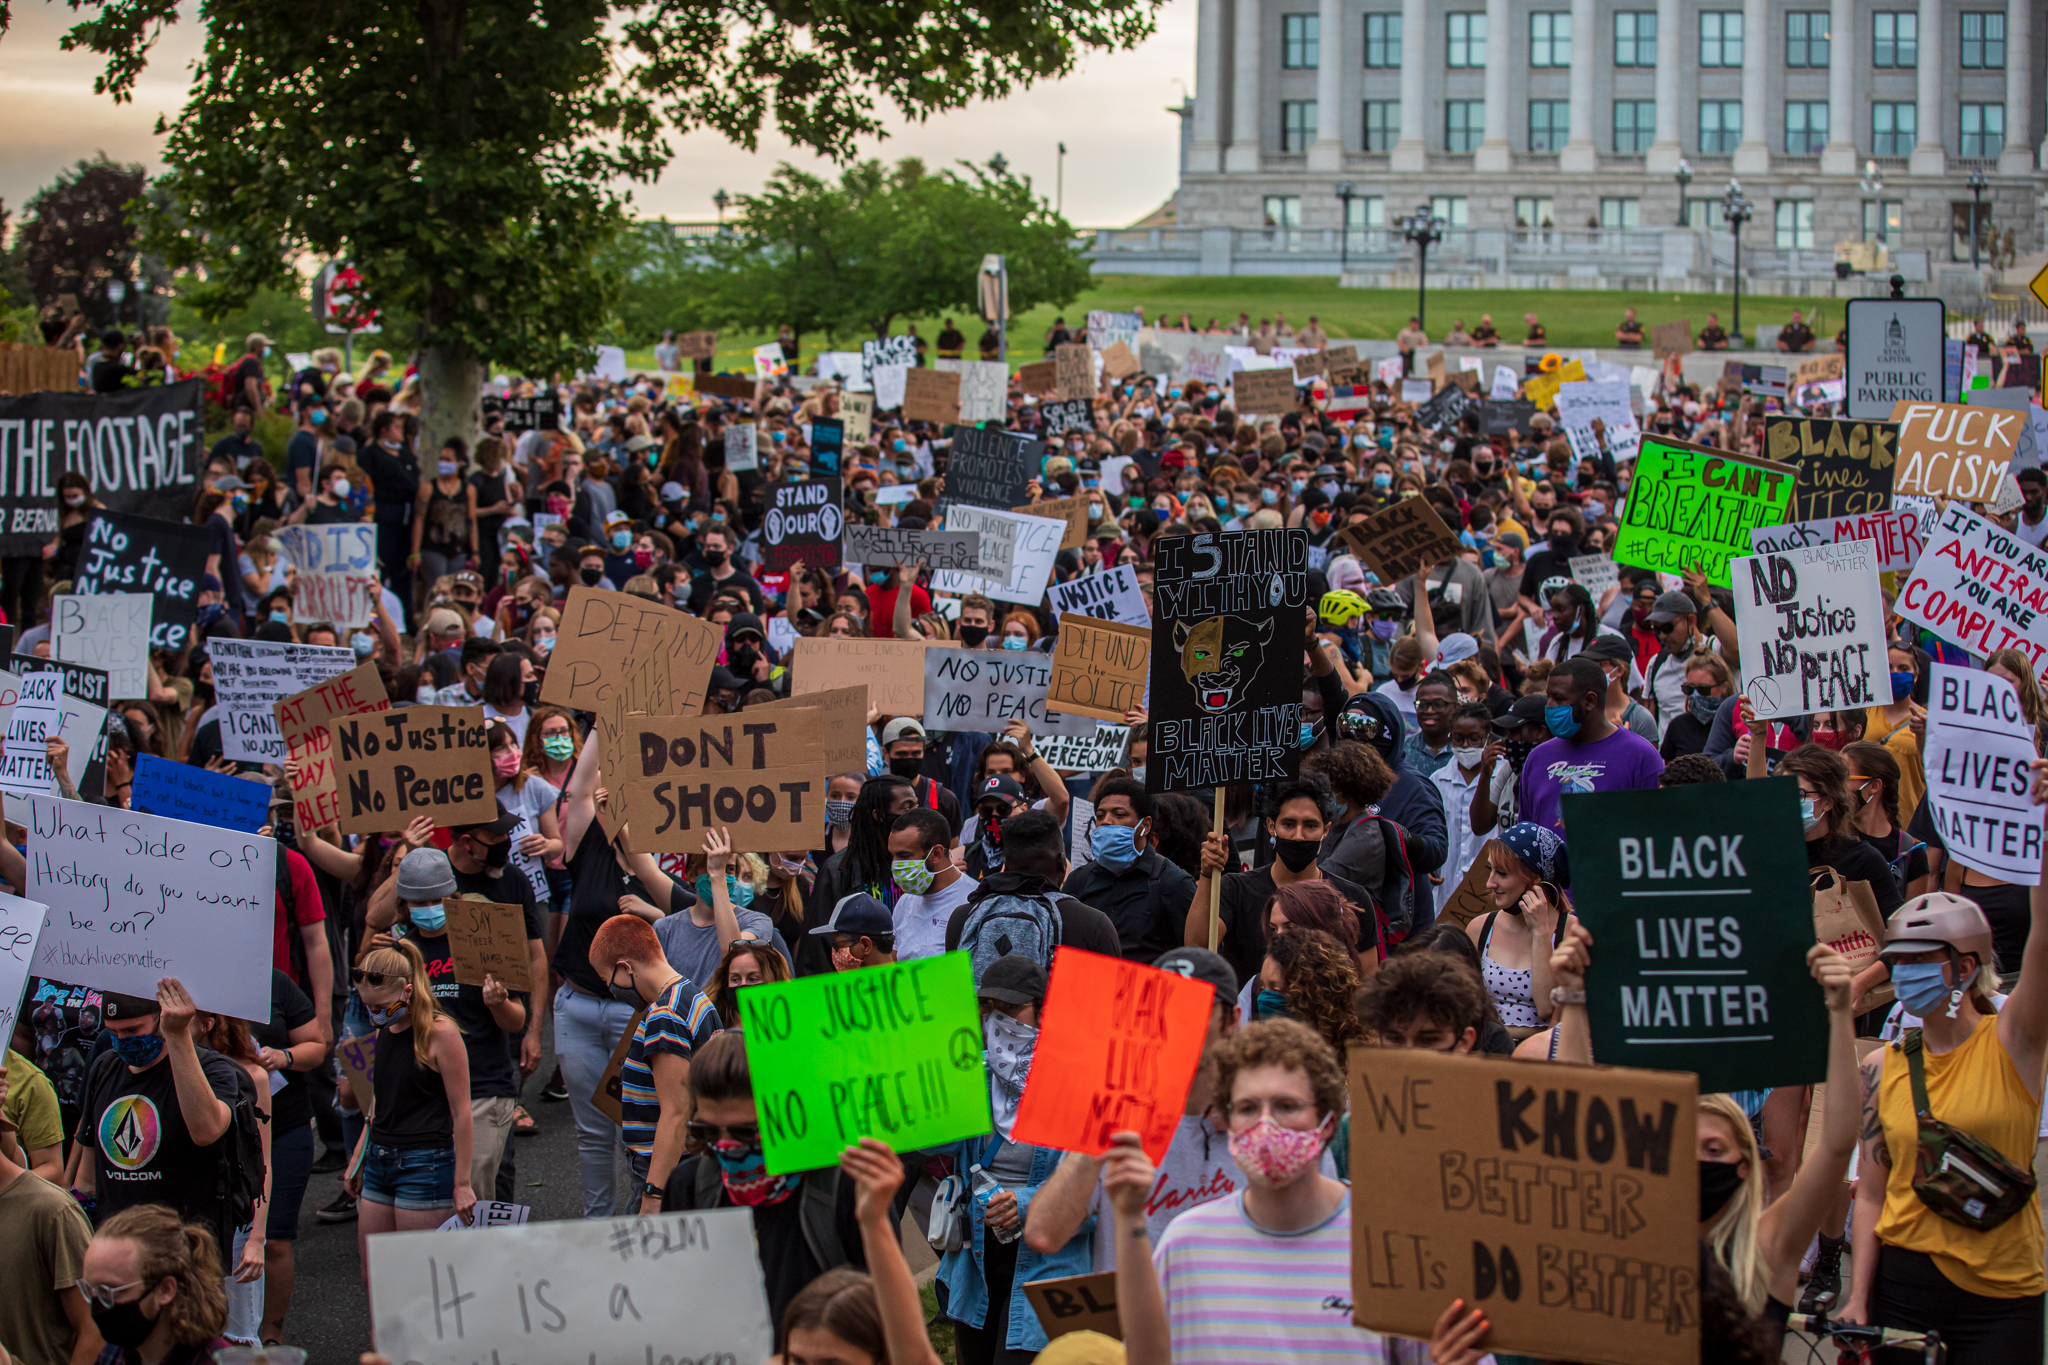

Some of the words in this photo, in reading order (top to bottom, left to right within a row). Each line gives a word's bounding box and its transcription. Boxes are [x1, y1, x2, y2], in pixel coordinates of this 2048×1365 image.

[864, 335, 916, 356] BLACK
[1877, 355, 1912, 363] CAPITOL
[1857, 388, 1933, 402] PARKING
[1864, 371, 1927, 386] PUBLIC
[1042, 400, 1086, 419] COLOR
[1900, 404, 2015, 448] FUCK
[0, 419, 56, 497] THE
[64, 410, 196, 493] FOOTAGE
[963, 429, 1030, 462] SILENCE
[1767, 420, 1896, 470] BLACK
[950, 451, 1025, 485] PROMOTES
[1663, 451, 1694, 479] I
[1702, 458, 1784, 501] CAN'T
[776, 484, 828, 507] STAND
[957, 477, 1013, 503] VIOLENCE
[785, 515, 817, 534] OUR
[951, 509, 971, 529] NO
[978, 515, 1015, 540] JUSTICE
[1347, 507, 1420, 546] BLACK
[1626, 475, 1783, 550] BREATHE
[89, 516, 129, 551] No
[849, 525, 921, 543] WHITE
[872, 540, 946, 555] SILENCE
[950, 542, 966, 555] IS
[1370, 522, 1437, 562] LIVES
[1756, 523, 1820, 553] Black
[1834, 512, 1923, 566] MATTER
[1942, 509, 1981, 536] IF
[1985, 529, 2020, 559] YOU
[892, 553, 979, 570] VIOLENCE
[1157, 537, 1185, 581] I
[1191, 529, 1309, 579] STAND
[1381, 537, 1464, 581] MATTER
[1802, 548, 1834, 565] BLACK
[1837, 541, 1869, 557] LIVES
[1826, 557, 1869, 573] MATTER
[86, 546, 195, 599] Justice
[1057, 570, 1129, 611] JUSTICE
[1749, 554, 1798, 606] NO
[1085, 600, 1120, 620] FOR
[1157, 574, 1250, 619] WITH
[1251, 572, 1307, 608] YOU
[1954, 575, 1991, 605] YOU
[1992, 596, 2036, 630] ARE
[60, 598, 147, 634] BLACK
[1776, 594, 1856, 642] Justice
[57, 635, 139, 663] LIVES
[800, 641, 831, 655] NOT
[838, 641, 866, 656] ALL
[874, 643, 904, 656] LIVES
[1064, 624, 1147, 671] DEFUND
[244, 665, 257, 677] YOU
[258, 666, 293, 676] FOLLOWING
[857, 664, 889, 673] UNTIL
[936, 657, 979, 682] NO
[1087, 663, 1106, 677] the
[1761, 639, 1798, 676] NO
[1799, 643, 1875, 712] PEACE
[281, 697, 307, 732] AT
[315, 676, 366, 714] THE
[936, 691, 972, 718] NO
[986, 693, 1062, 724] PEACE
[1055, 669, 1145, 713] POLICE
[1941, 676, 2024, 726] BLAC
[7, 719, 47, 743] LIVES
[339, 720, 380, 761] No
[385, 713, 486, 751] Justice
[831, 719, 844, 730] TO
[1155, 711, 1249, 754] BLACK
[1252, 703, 1303, 749] LIVES
[242, 739, 258, 753] NO
[287, 725, 332, 762] END
[639, 722, 777, 777] DONT
[0, 755, 52, 781] MATTER
[165, 772, 178, 785] not
[212, 788, 224, 798] but
[227, 791, 235, 801] I
[293, 759, 325, 791] DAY
[1164, 747, 1288, 790] MATTER
[1941, 748, 2030, 797] LIVES
[157, 791, 170, 804] not
[204, 807, 218, 818] but
[220, 808, 231, 821] I
[234, 814, 248, 824] see
[349, 769, 385, 818] No
[394, 765, 484, 811] Peace
[653, 781, 810, 835] SHOOT
[32, 799, 107, 843] What
[123, 823, 186, 861] Side
[209, 845, 259, 871] Of
[1930, 802, 2042, 860] MATTER
[1619, 834, 1747, 879] BLACK
[35, 851, 110, 912] History
[124, 873, 143, 896] do
[159, 883, 183, 914] you
[196, 890, 260, 911] want
[69, 911, 97, 931] be
[110, 911, 155, 941] on?
[469, 908, 493, 934] SAY
[1636, 916, 1742, 959] LIVES
[42, 940, 174, 970] #blacklivesmatter
[467, 934, 497, 948] THEIR
[479, 951, 503, 965] NAMES
[1817, 930, 1876, 954] mith's
[66, 998, 84, 1008] THE
[71, 987, 88, 998] N
[746, 994, 792, 1044] NO
[819, 963, 934, 1041] JUSTICE
[1620, 985, 1769, 1027] MATTER
[761, 1089, 808, 1149] NO
[1362, 1073, 1434, 1135] WE
[1495, 1080, 1678, 1176] KNOW
[105, 1169, 162, 1181] VOLCOM
[1440, 1150, 1647, 1240] BETTER
[608, 1214, 709, 1262] #BLM
[428, 1255, 476, 1340] It
[514, 1270, 568, 1334] is
[608, 1282, 642, 1322] a
[1472, 1240, 1521, 1301] DO
[1536, 1242, 1697, 1336] BETTER
